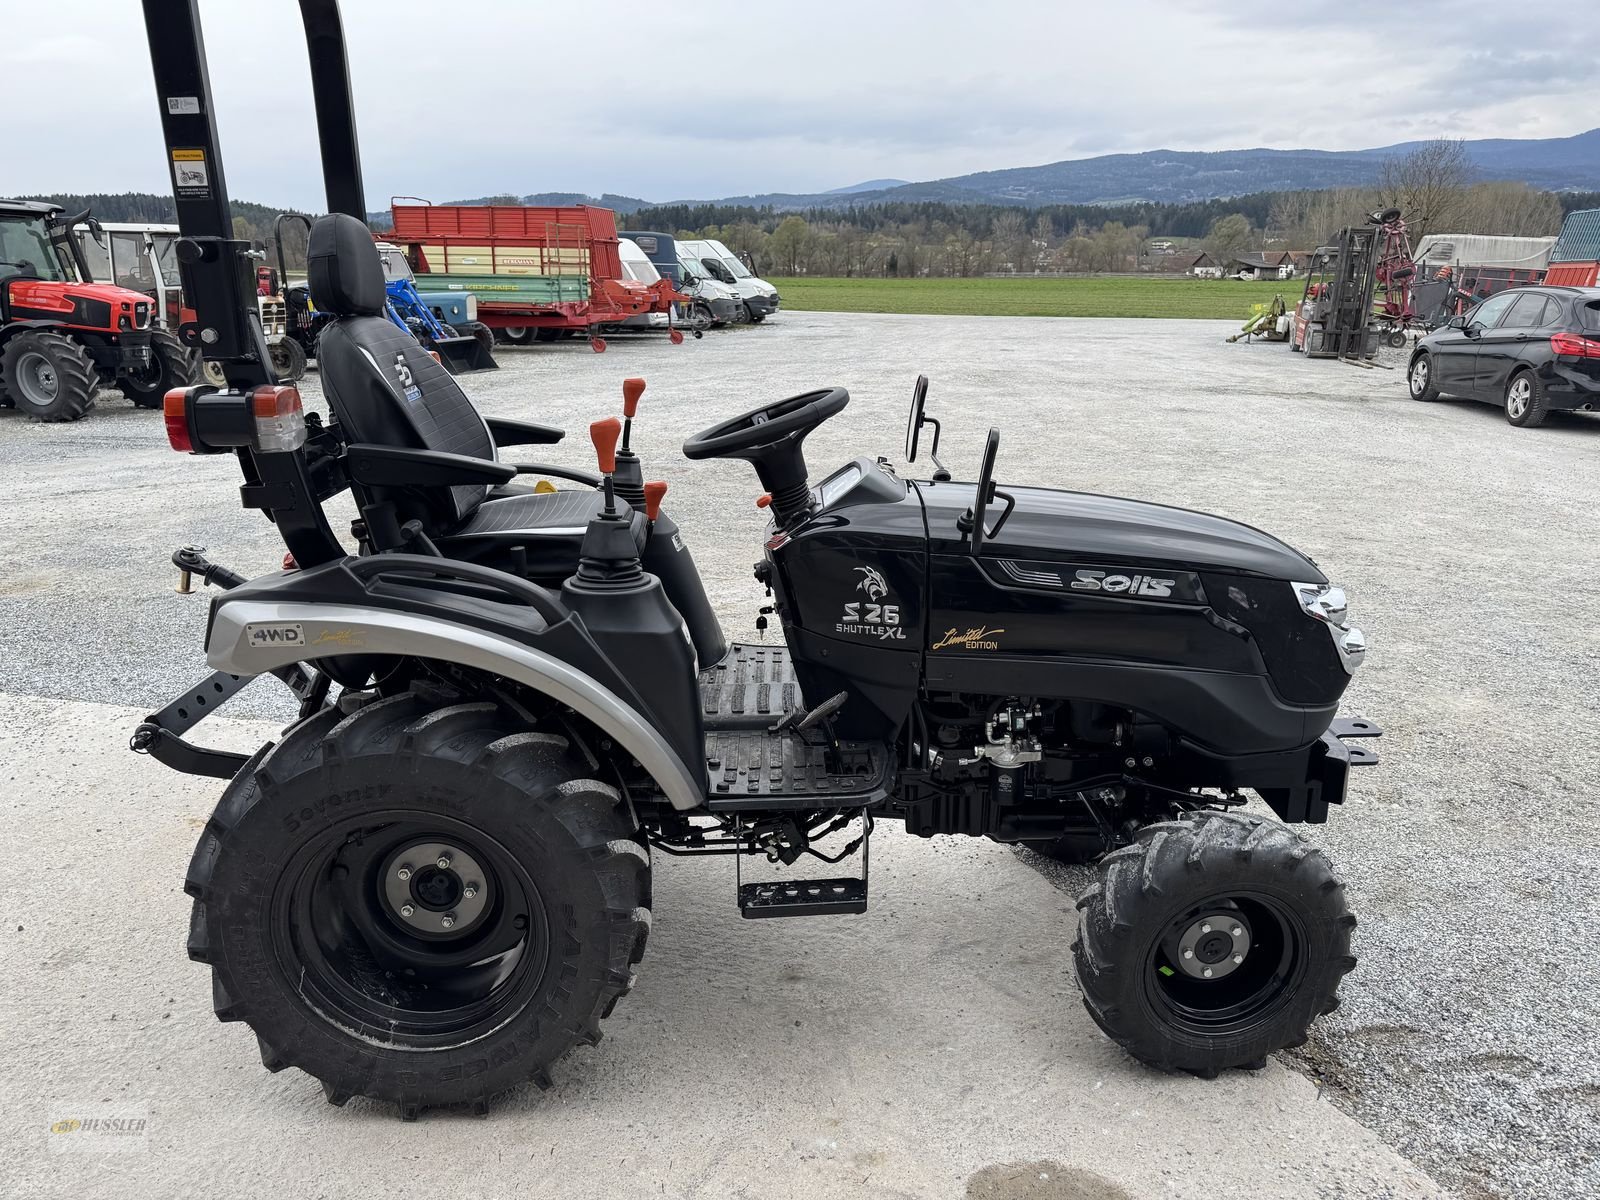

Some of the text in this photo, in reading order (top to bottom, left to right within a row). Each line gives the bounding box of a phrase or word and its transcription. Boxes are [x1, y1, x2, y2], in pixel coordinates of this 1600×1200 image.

[253, 628, 299, 642] 4WD
[932, 625, 1005, 650] Limited
[965, 641, 998, 650] EDITION
